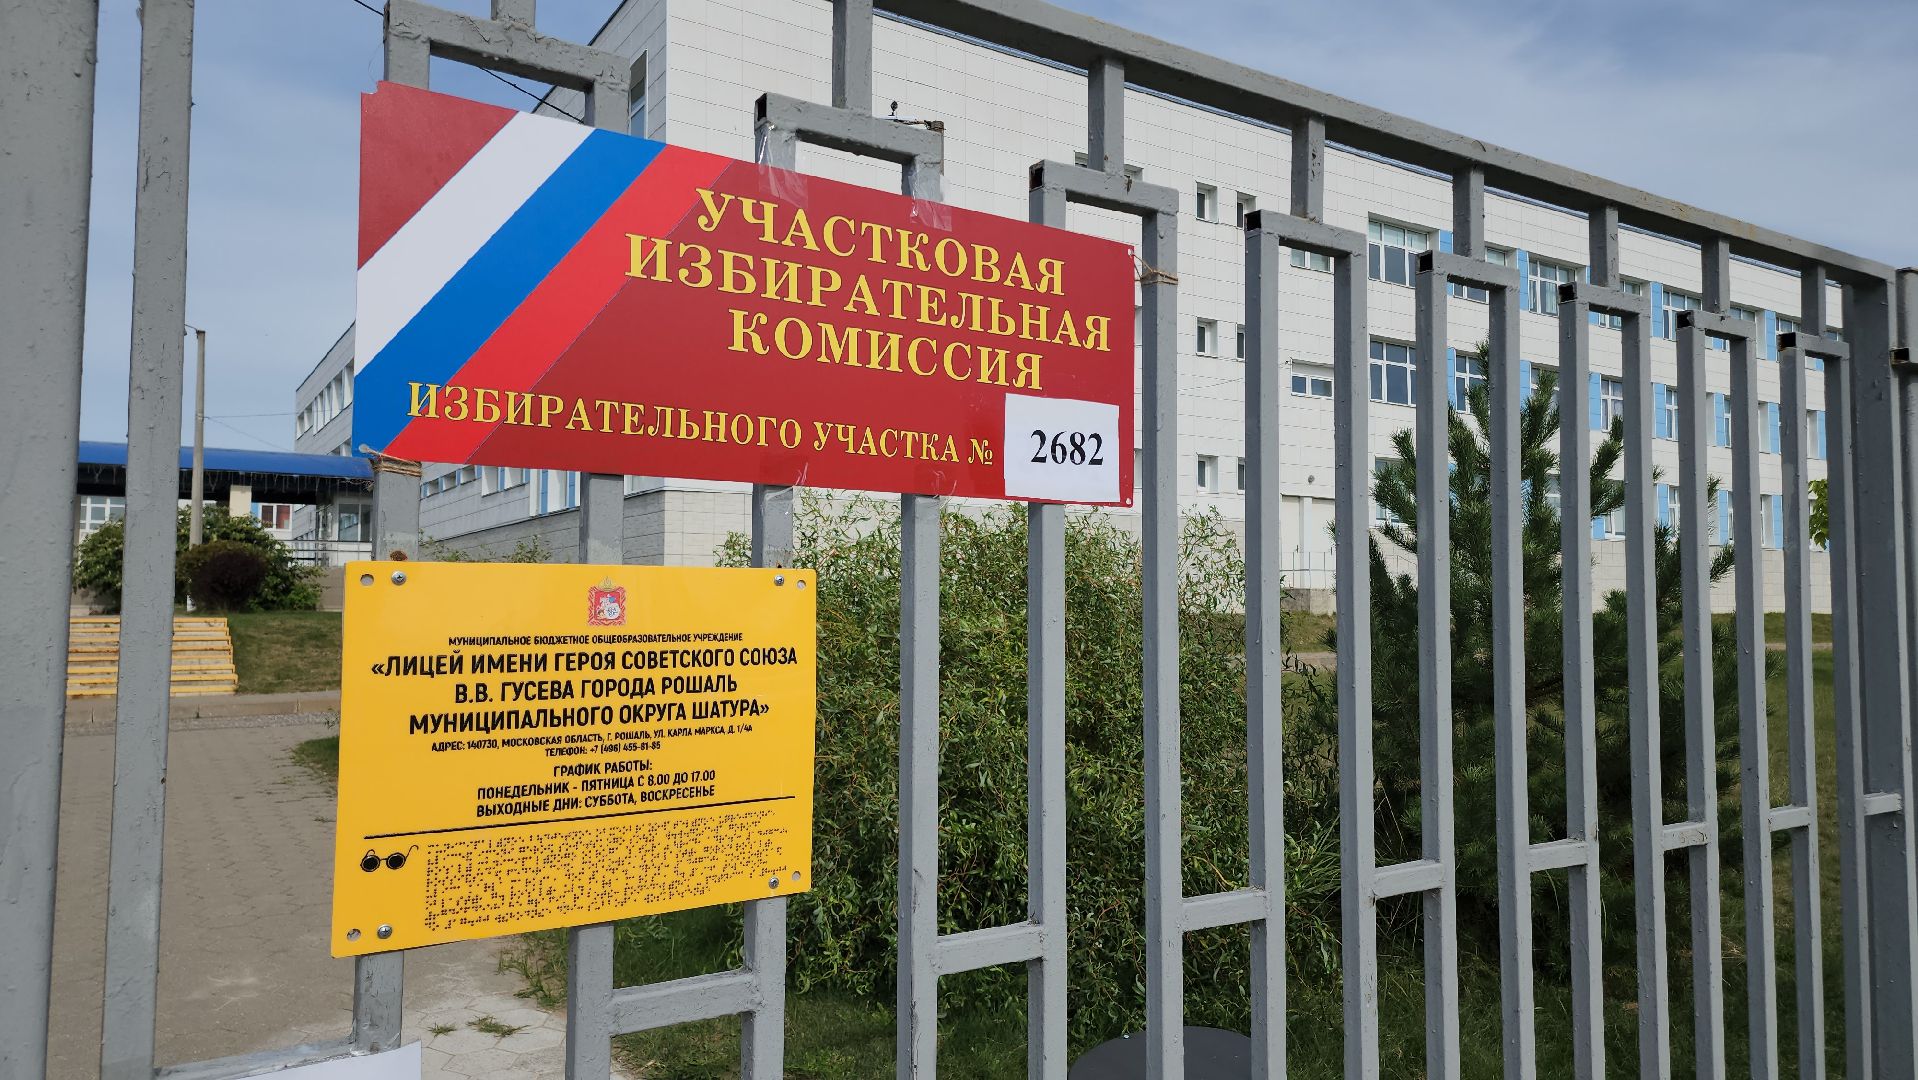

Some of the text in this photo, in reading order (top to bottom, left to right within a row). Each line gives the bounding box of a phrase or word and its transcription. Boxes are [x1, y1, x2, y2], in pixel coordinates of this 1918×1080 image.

[696, 187, 1066, 297] УЧАСТКОВАЯ
[624, 233, 1112, 353] ИЗБИРАТЕЛЬНАЯ
[727, 309, 1044, 391] КОМИССИЯ
[407, 381, 993, 467] ИЗБИРАТЕЛЬНОГО УЧАСТКА №
[1030, 429, 1105, 467] 2682
[448, 632, 743, 647] МУНИЦИПАЛЬНОЕ БЮДЖЕТНОЕ ОБЩЕОБРАЗОВАТЕЛЬНОЕ УЧРЕЖДЕНИЕ
[371, 647, 798, 678] «ЛИЦЕЙ ИМЕНИ ГЕРОЯ СОВЕТСКОГО СОЮЗА
[455, 674, 738, 704] В.В. ГУСЕВА ГОРОДА РОШАЛЬ
[409, 698, 770, 735] МУНИЦИПАЛЬНОГО ОКРУГА ШАТУРА»
[431, 740, 466, 752] АДРЕС:
[467, 738, 500, 750] 140730,
[501, 735, 563, 748] МОСКОВСКАЯ
[564, 733, 605, 744] ОБЛАСТЬ,
[614, 730, 652, 741] РОШАЛЬ,
[653, 729, 666, 739] УЛ.
[667, 727, 693, 738] КАРЛА
[545, 745, 588, 757] ТЕЛЕФОН:
[589, 744, 599, 754] +7
[600, 742, 621, 755] (496)
[553, 759, 653, 777] ГРАФИК РАБОТЫ:
[477, 781, 570, 800] ПОНЕДЕЛЬНИК
[581, 776, 635, 793] ПЯТНИЦА
[637, 774, 645, 787] С
[647, 772, 670, 787] 8.00
[672, 771, 689, 786] ДО
[691, 769, 716, 783] 17.00
[476, 785, 715, 818] ВЫХОДНЫЕ ДНИ: СУББОТА, ВОСКРЕСЕНЬЕ
